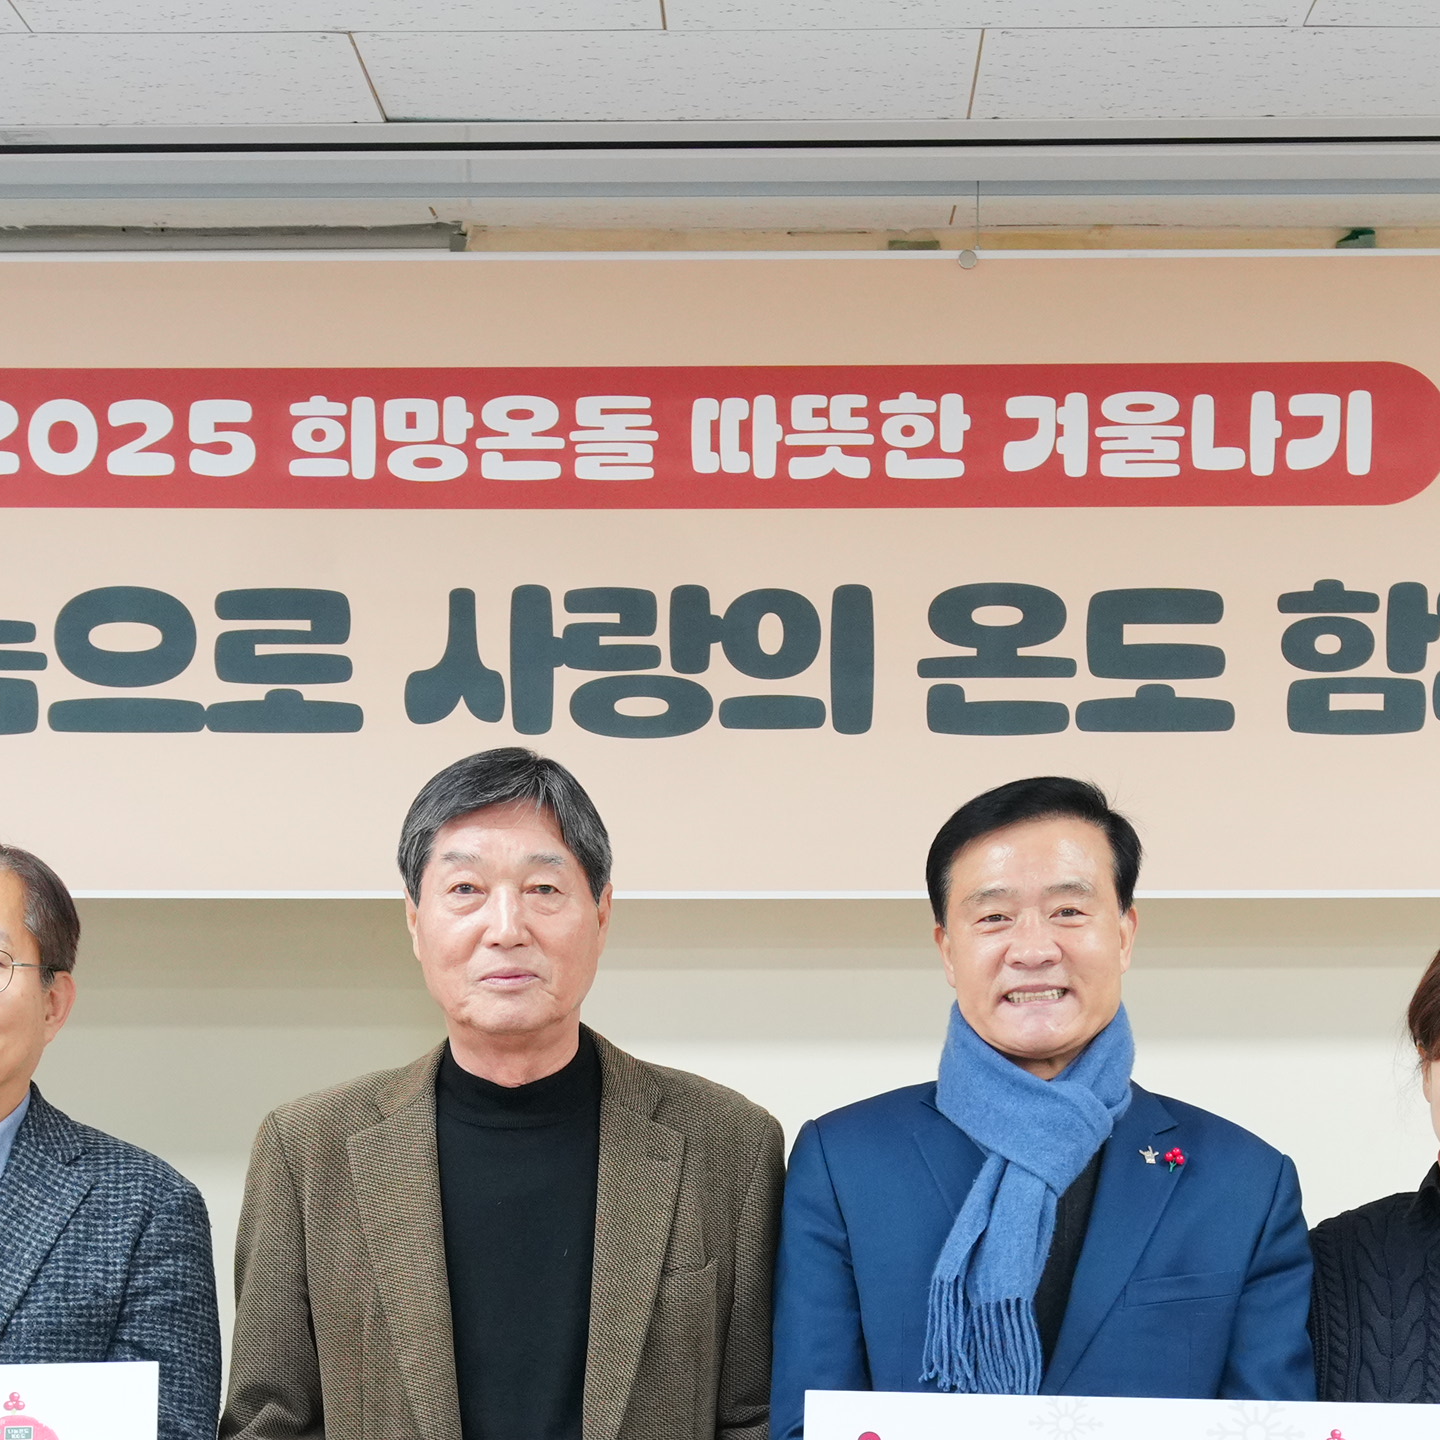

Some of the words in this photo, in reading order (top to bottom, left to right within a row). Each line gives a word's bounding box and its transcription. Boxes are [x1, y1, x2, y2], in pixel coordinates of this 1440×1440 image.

[289, 395, 659, 482] 희망온돌
[691, 392, 971, 479] 따뜻한
[1003, 390, 1372, 478] 겨울나기
[404, 584, 874, 738] 사랑의
[917, 583, 1235, 736] 온도
